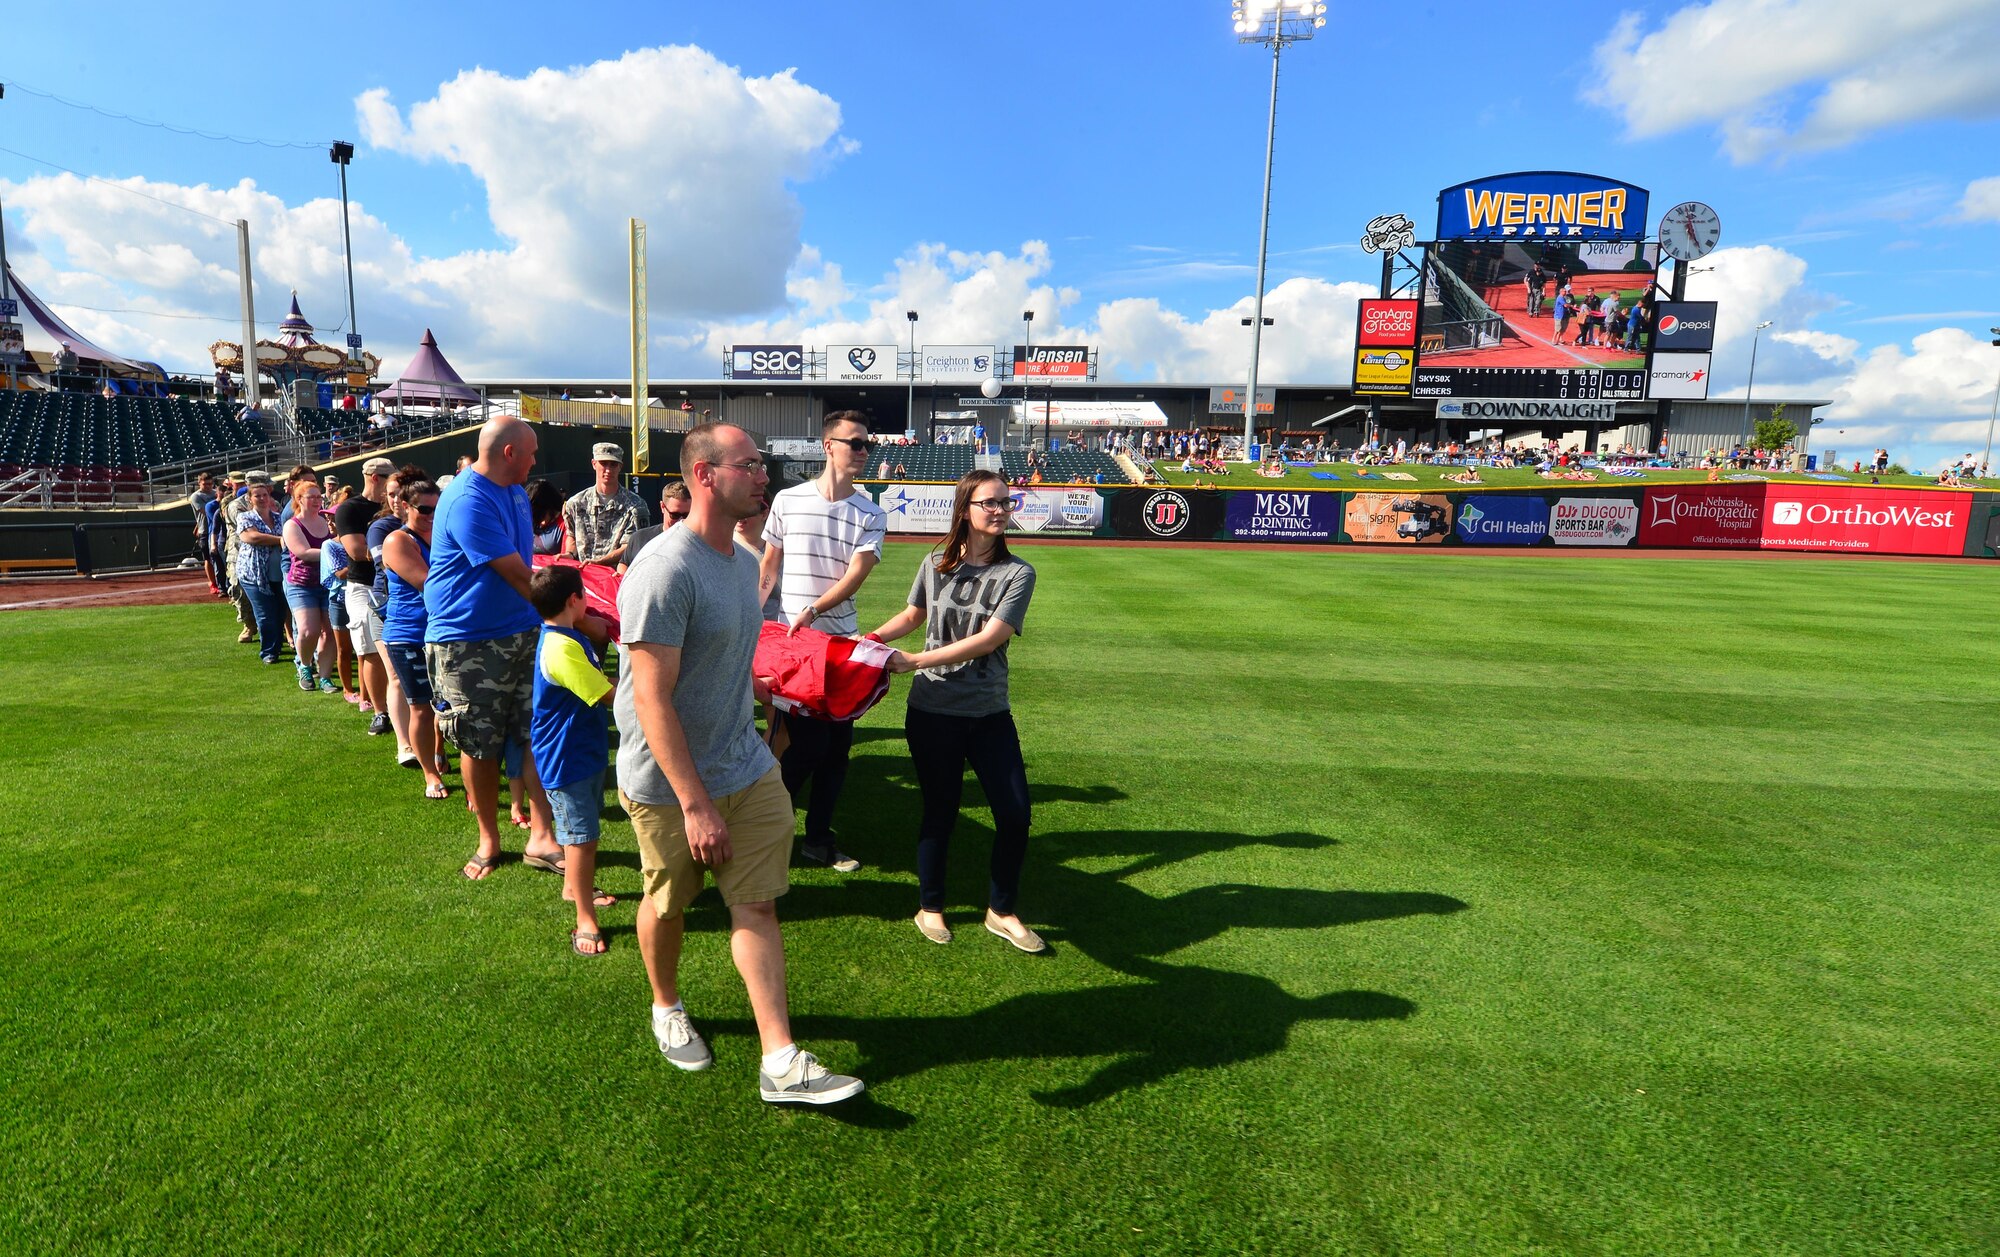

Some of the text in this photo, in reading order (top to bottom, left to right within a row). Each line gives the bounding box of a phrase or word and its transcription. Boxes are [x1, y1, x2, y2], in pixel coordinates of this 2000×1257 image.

[1465, 188, 1626, 230] WERNER
[1502, 226, 1582, 236] PARK
[1366, 308, 1412, 322] ConAgra
[1378, 319, 1411, 331] Foods
[1680, 320, 1710, 330] pepsi
[752, 351, 800, 371] sac
[926, 356, 969, 367] Creighton
[1028, 348, 1084, 363] Jensen
[1562, 375, 1568, 386] 0
[1580, 375, 1586, 386] 0
[1590, 375, 1597, 386] 0
[1652, 370, 1690, 379] aramark
[1606, 375, 1641, 387] 0 0 0
[1560, 388, 1567, 398] 0
[1579, 388, 1585, 398] 0
[1589, 388, 1595, 398] 0
[1211, 403, 1273, 411] PARTYPTIO
[1470, 402, 1614, 418] DOWNDRAUGHT
[912, 498, 952, 507] AMERI
[1254, 493, 1311, 517] MSM
[1706, 497, 1744, 508] Nebraska
[1061, 506, 1094, 514] WINNING
[1156, 504, 1177, 524] JJ
[1582, 506, 1633, 519] DUGOUT
[1676, 502, 1758, 521] Orthopaedic
[1806, 504, 1954, 528] OrthoWest
[1252, 517, 1312, 529] PRINTING
[1482, 520, 1546, 534] CHI Health
[1555, 520, 1586, 530] SPORTS
[1588, 520, 1604, 531] BAR
[1719, 519, 1752, 530] Hospital
[1715, 536, 1748, 545] Orthopaedic
[1760, 538, 1786, 546] Sports
[1788, 538, 1827, 547] Medicine
[933, 568, 1013, 610] YOU
